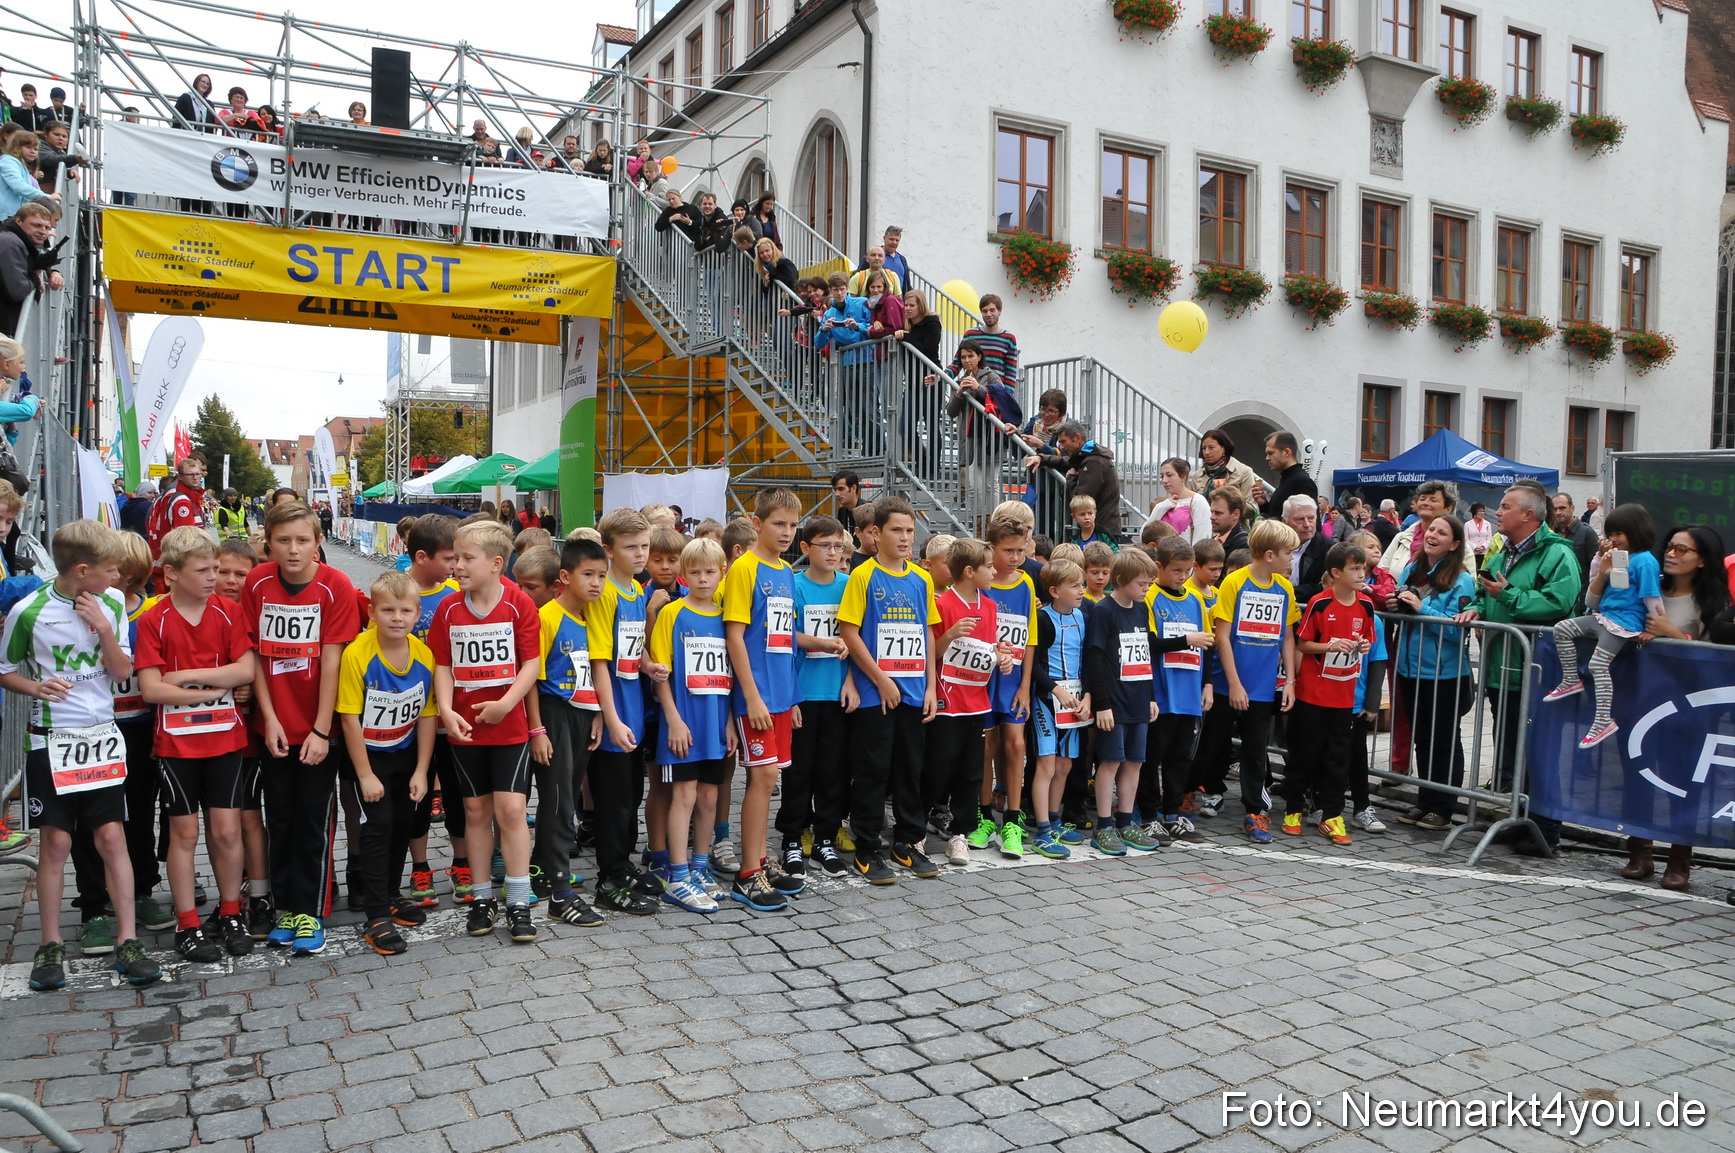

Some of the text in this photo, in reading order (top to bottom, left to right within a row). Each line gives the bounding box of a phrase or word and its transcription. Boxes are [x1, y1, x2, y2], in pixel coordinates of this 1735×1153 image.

[270, 157, 526, 201] BMW EfficientDynamics
[334, 186, 409, 206] Verbrauch.
[413, 195, 448, 210] Mehr
[135, 249, 255, 270] Neumarkter Stadtlauf
[287, 243, 461, 293] START
[134, 285, 241, 301] Neumarkter Stadtlauf
[490, 281, 589, 297] Neumarkter Stadtlauf
[450, 312, 541, 327] Neumarkter Stadtlauf
[140, 378, 170, 450] Audi BKK
[1357, 471, 1426, 483] Neumarkter Tagblatt
[263, 604, 278, 612] ARTL
[1246, 602, 1280, 622] 7597
[264, 614, 315, 640] 7067
[271, 644, 302, 655] Lorenz
[456, 638, 509, 664] 7055
[884, 637, 922, 657] 7172
[893, 661, 917, 670] Marcel
[948, 646, 993, 671] 7163
[469, 669, 495, 679] Lukas
[705, 677, 726, 687] Jakob
[954, 669, 975, 680] Linus
[368, 696, 392, 704] PARTL
[373, 699, 421, 726] 7195
[57, 737, 120, 767] 7012
[75, 769, 108, 782] Niklas
